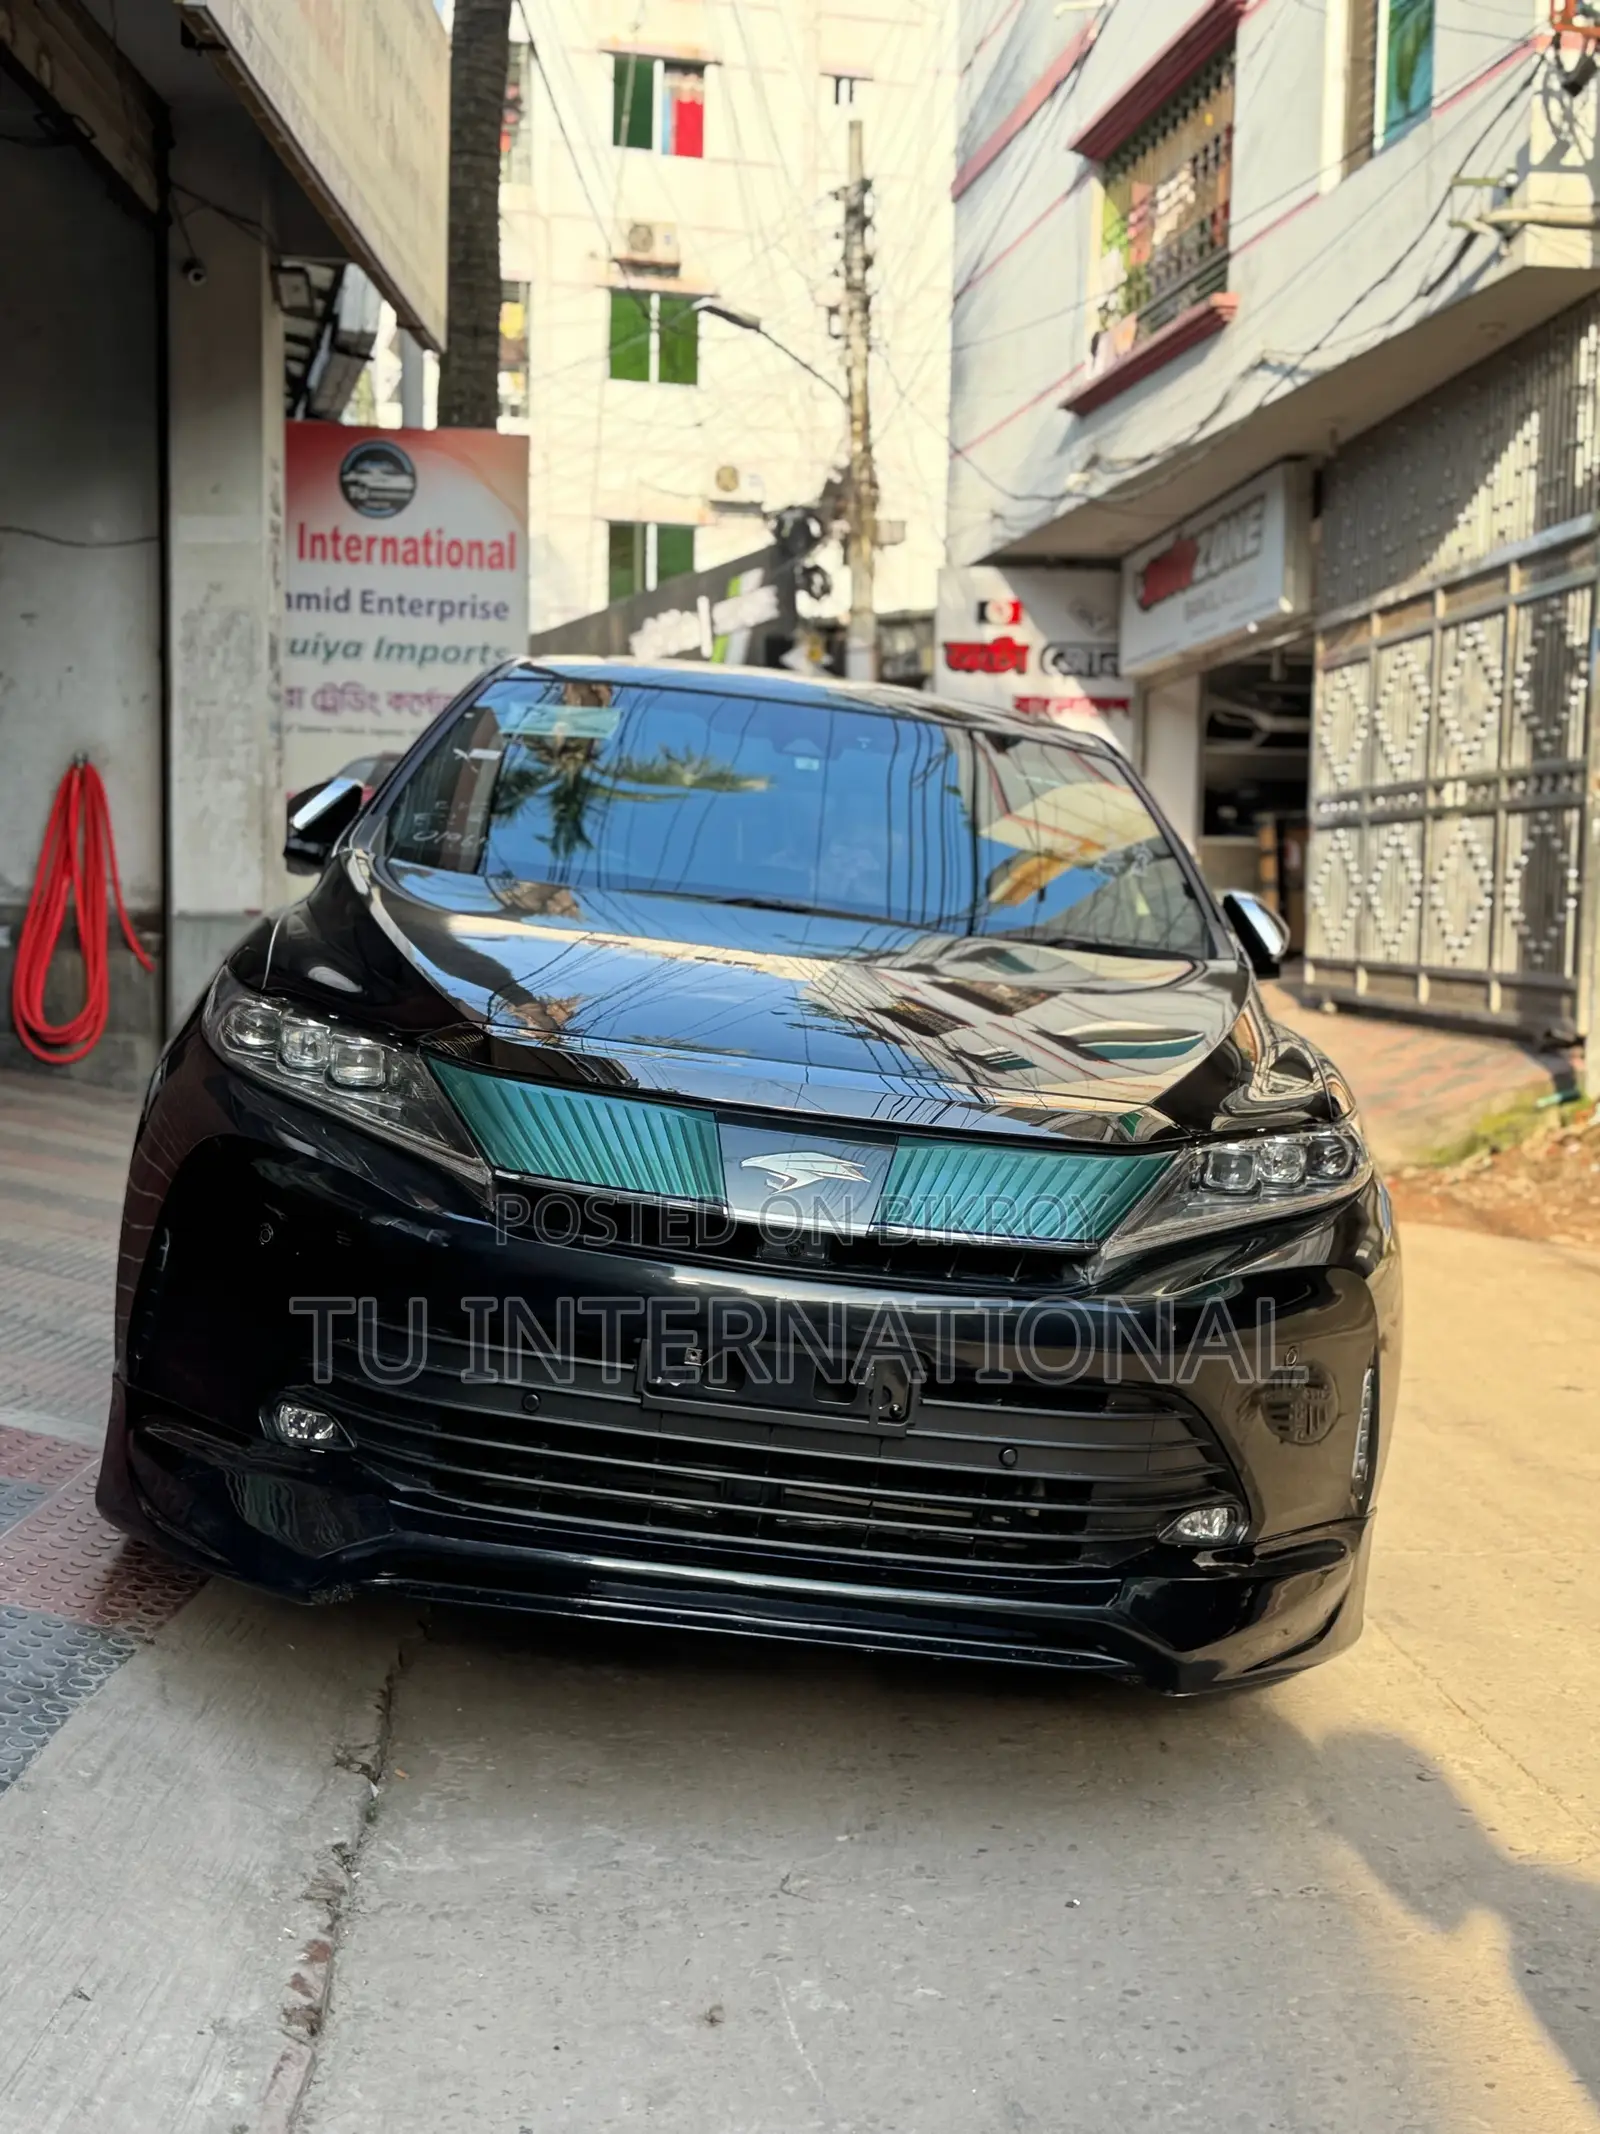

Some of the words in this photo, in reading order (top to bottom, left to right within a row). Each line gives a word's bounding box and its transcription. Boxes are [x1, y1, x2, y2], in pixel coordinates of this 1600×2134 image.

[297, 522, 517, 571] International
[360, 588, 510, 625] Enterprise
[285, 631, 363, 666] uiya
[373, 635, 511, 669] Imports
